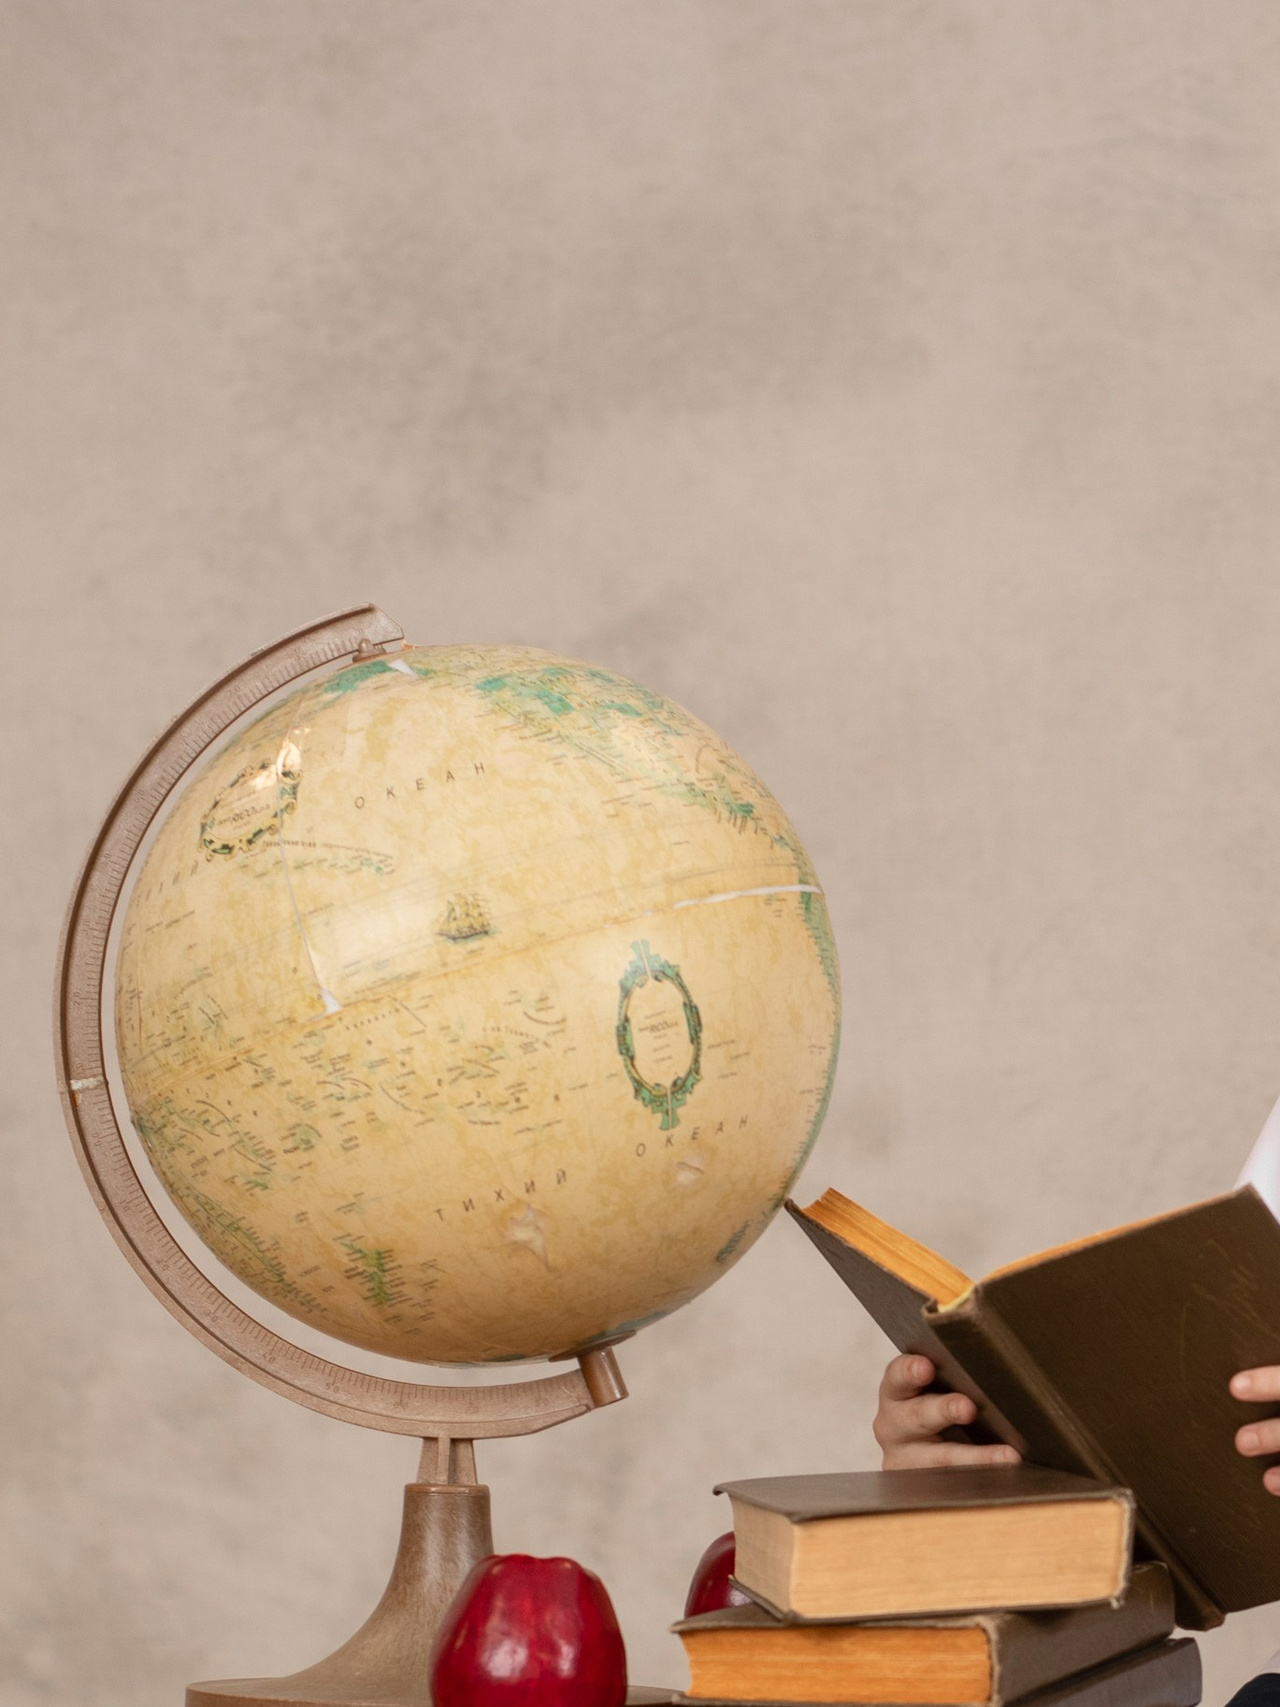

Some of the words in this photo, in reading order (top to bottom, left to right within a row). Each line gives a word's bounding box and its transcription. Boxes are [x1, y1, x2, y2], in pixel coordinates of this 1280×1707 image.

[354, 762, 485, 809] ОКЕАН
[434, 1168, 567, 1222] ТИХИЙ
[635, 1115, 749, 1158] ОКЕАН
